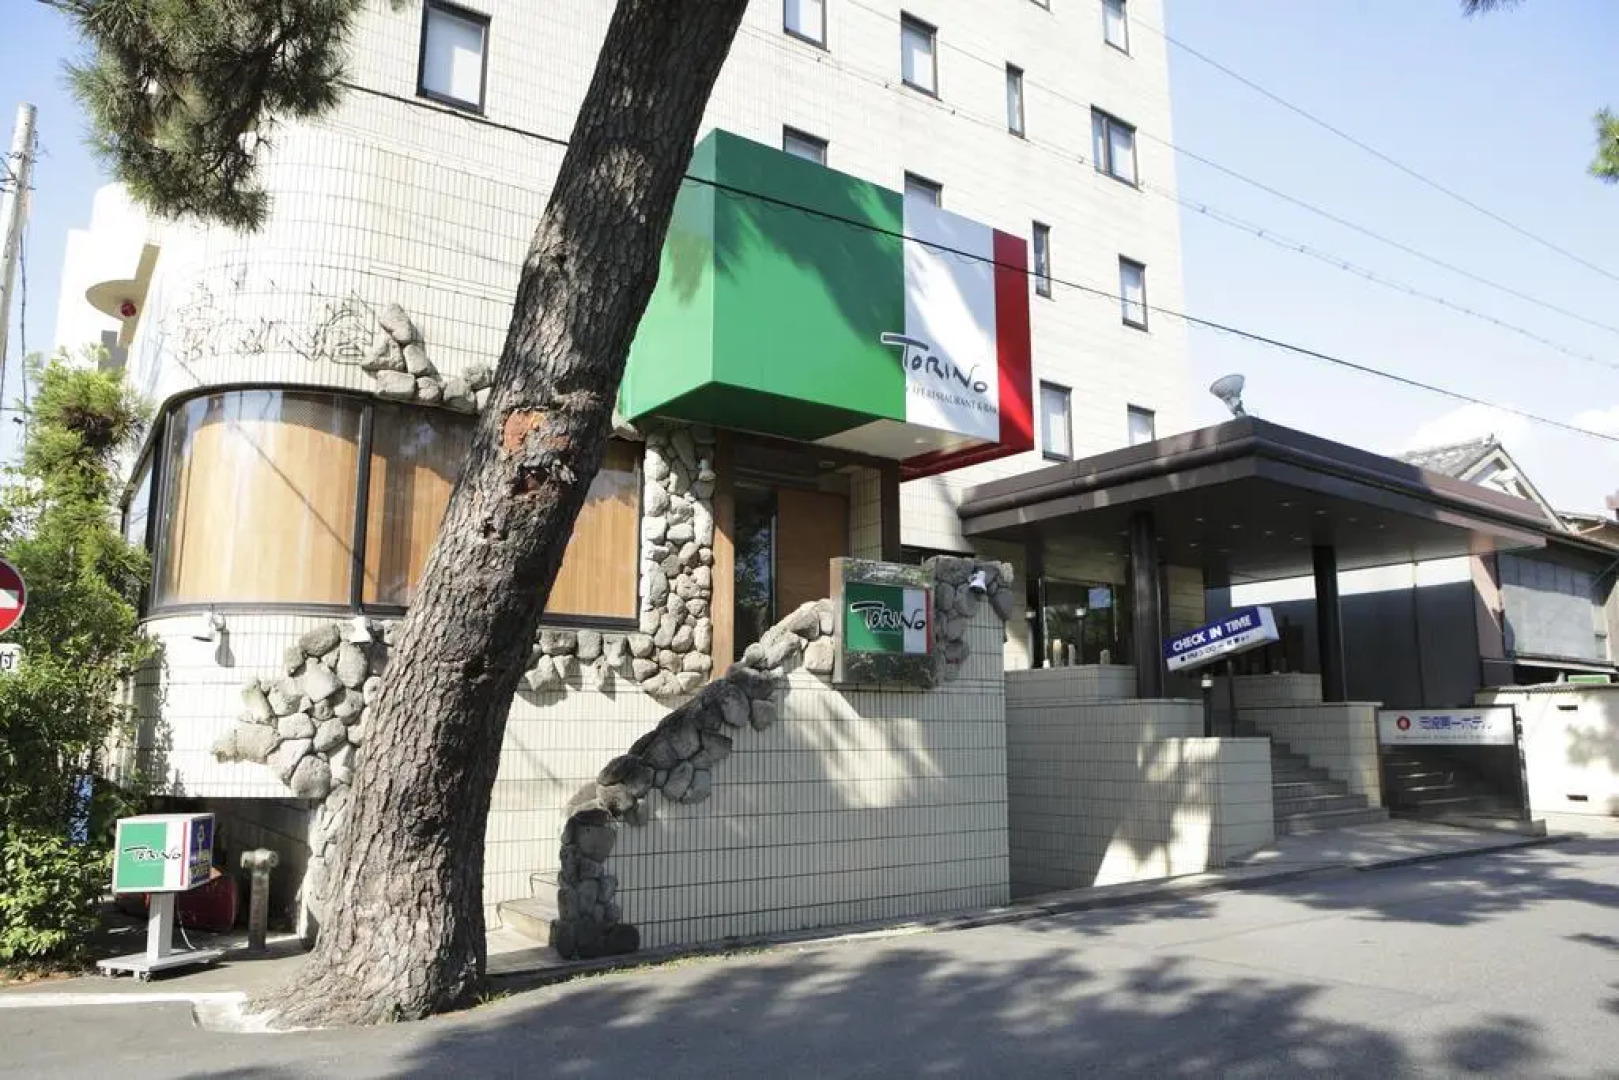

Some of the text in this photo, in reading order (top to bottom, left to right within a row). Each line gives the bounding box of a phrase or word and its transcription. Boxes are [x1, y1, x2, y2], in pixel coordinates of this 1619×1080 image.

[880, 332, 988, 393] TORINO
[850, 600, 926, 631] TORINO
[1172, 631, 1206, 652] CHECK
[1208, 625, 1222, 640] IN
[1225, 614, 1252, 633] TIME
